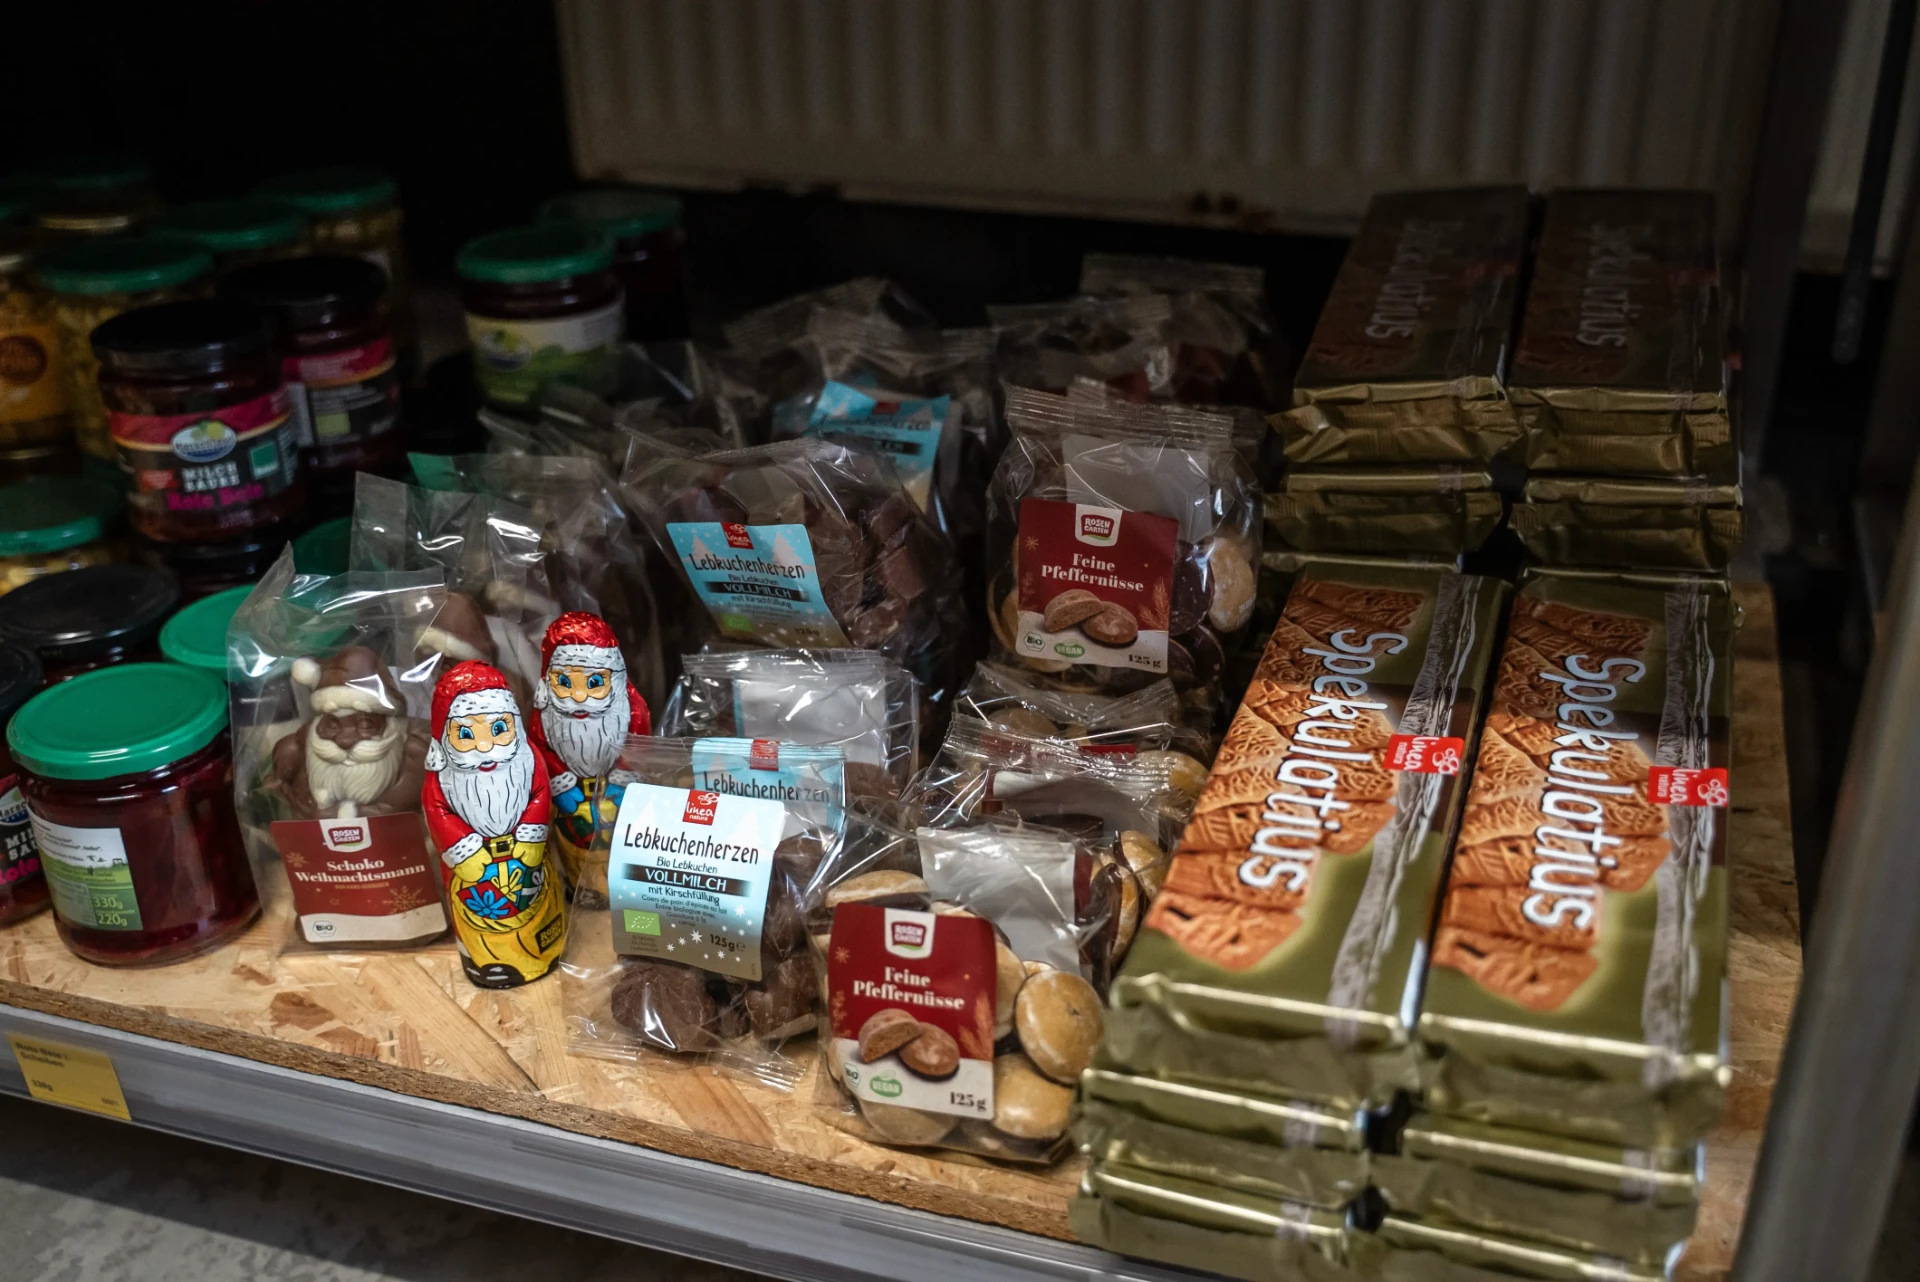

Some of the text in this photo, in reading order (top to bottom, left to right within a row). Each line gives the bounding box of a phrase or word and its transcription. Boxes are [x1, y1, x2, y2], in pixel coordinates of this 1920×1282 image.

[1084, 516, 1111, 528] ROSEN
[1084, 525, 1110, 535] GARTEN
[689, 553, 805, 579] Lebkuchenherzen
[1072, 552, 1116, 573] Feine
[1041, 564, 1144, 592] Pfeffernüsse
[723, 582, 792, 599] VOLLMILCH
[1239, 628, 1409, 893] Spekulatius
[1403, 736, 1440, 771] linea
[704, 771, 830, 802] Lebkuchenherzen
[1522, 653, 1647, 928] Spekulatius
[1669, 769, 1702, 804] linea
[686, 801, 714, 817] linea
[332, 829, 360, 838] ROSEN
[624, 824, 759, 864] Lebkuchenherzen
[294, 864, 427, 883] Weihnachtsmann
[326, 858, 386, 872] Schoko
[656, 856, 718, 875] Bio Lebkuchen
[645, 868, 727, 892] VOLLMILCH
[648, 886, 720, 906] mit Kirschfüllung
[884, 966, 932, 987] Feine
[853, 980, 965, 1011] Pfeffernüsse
